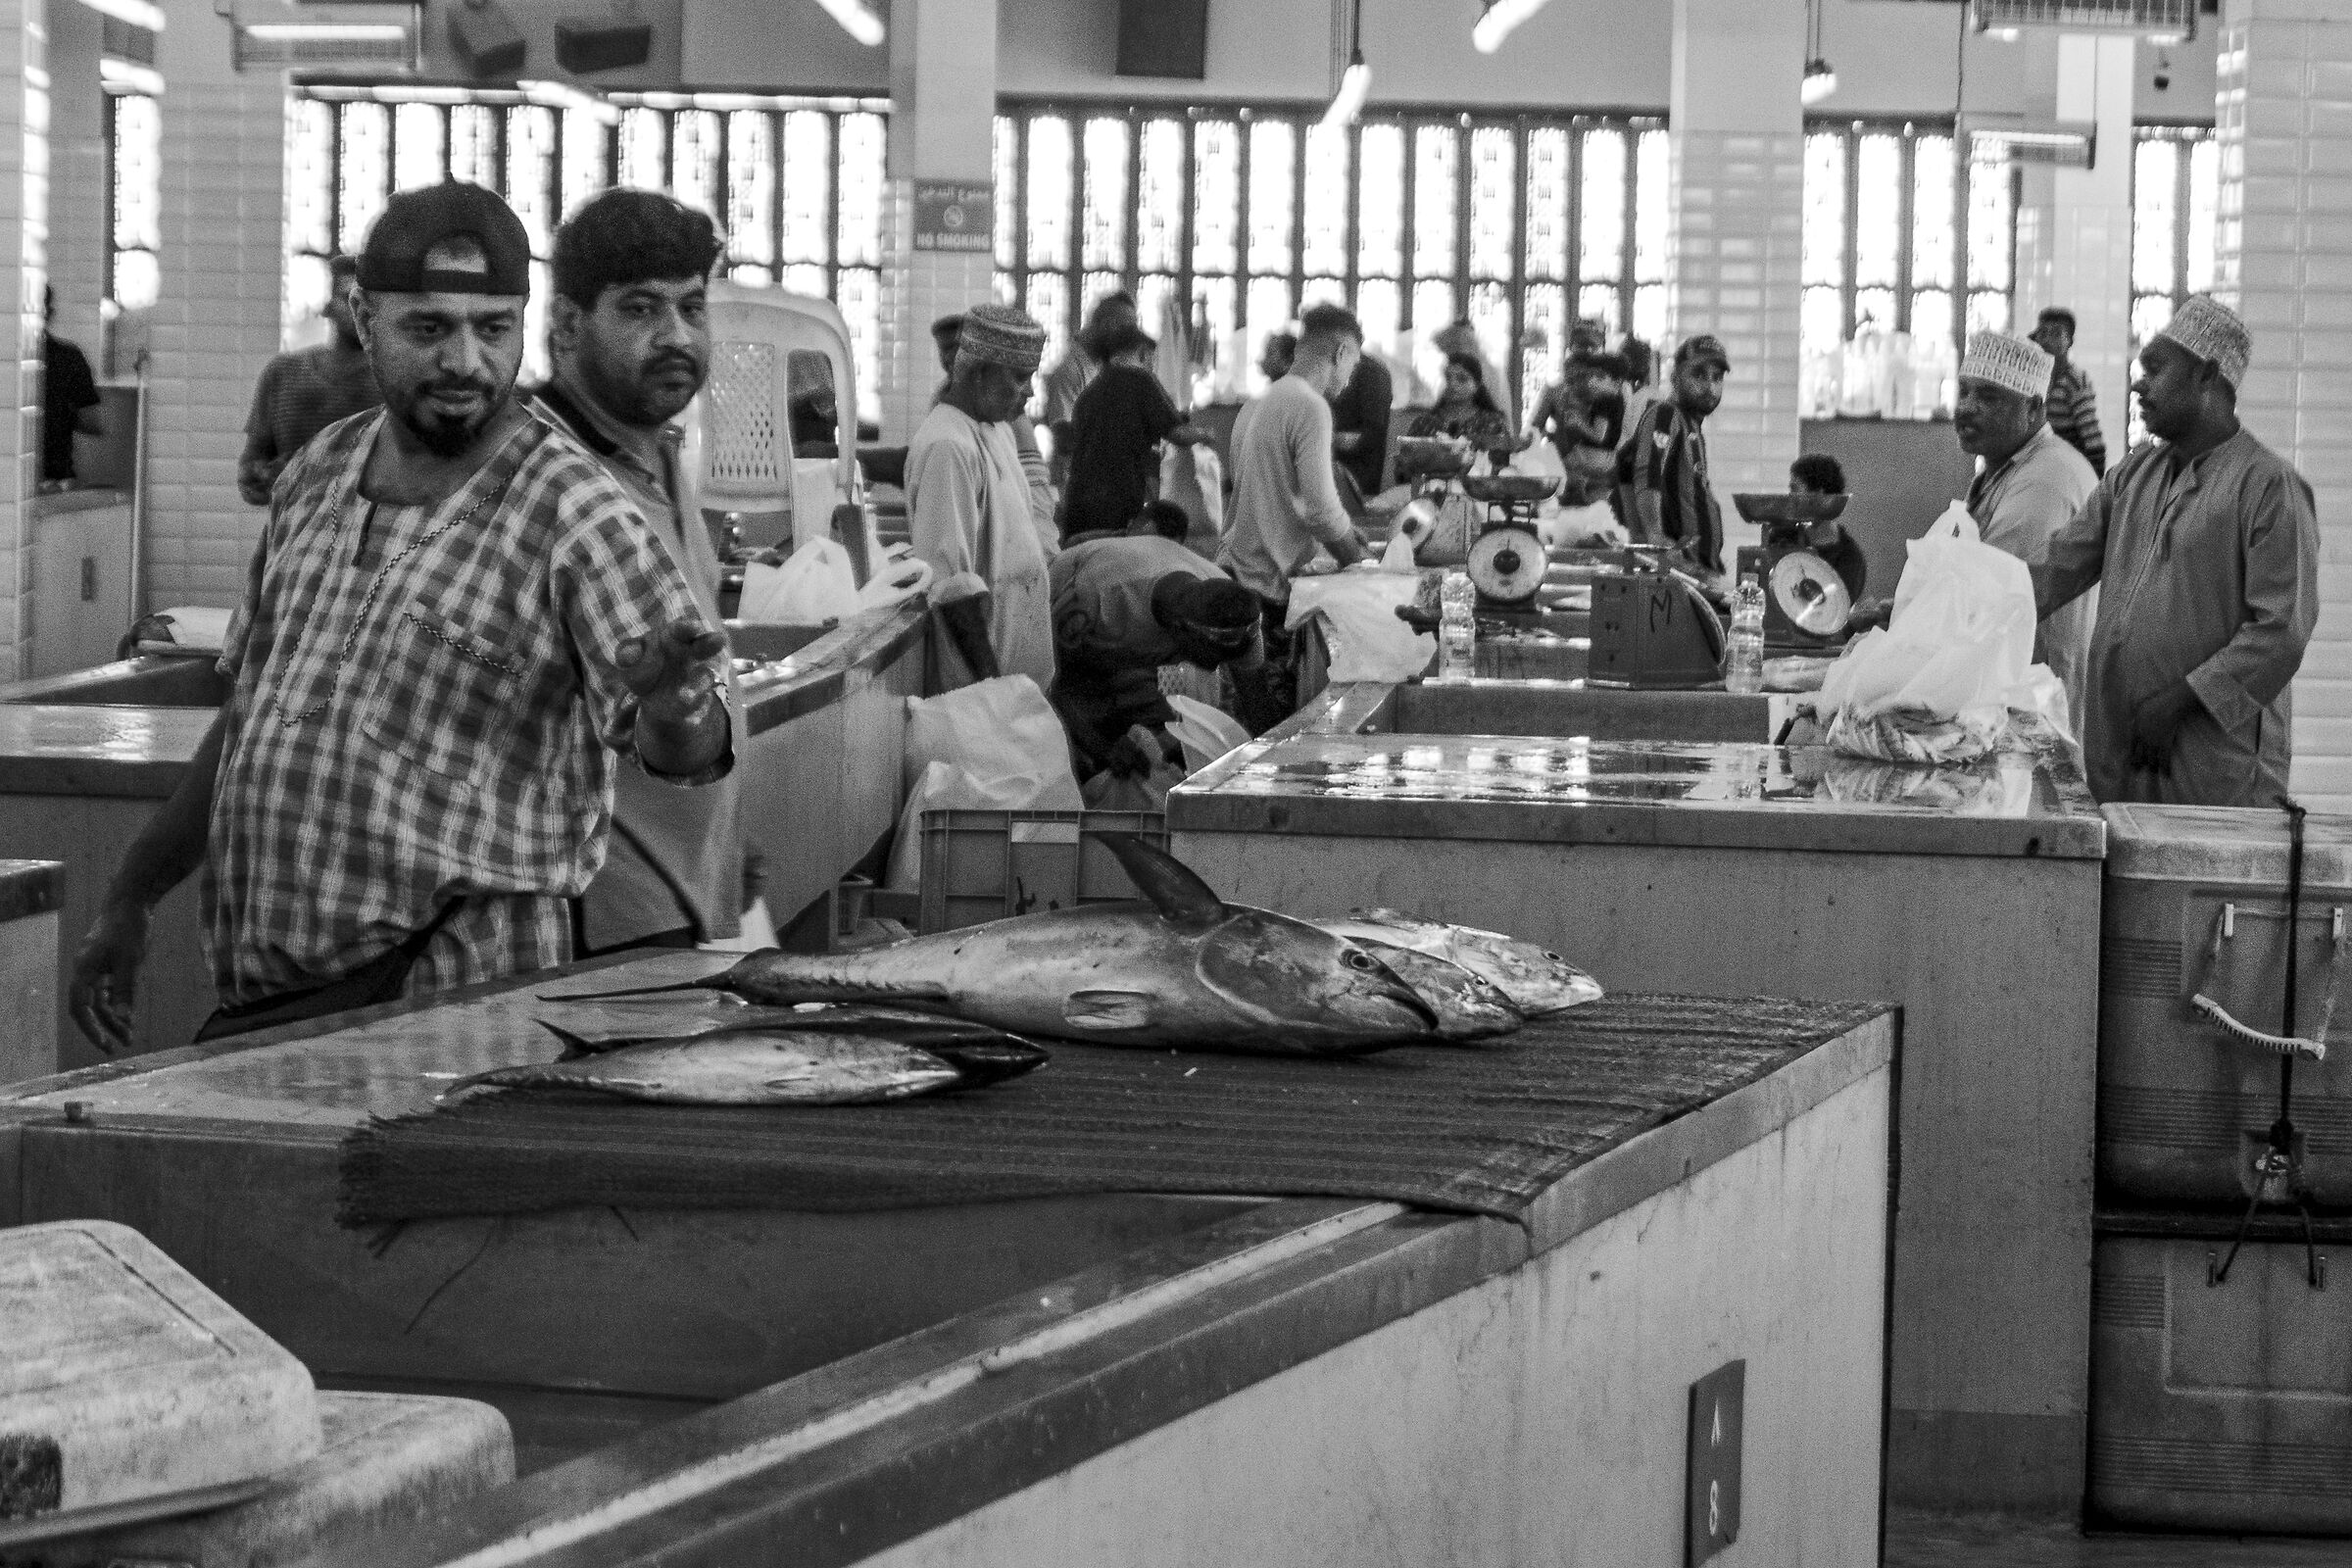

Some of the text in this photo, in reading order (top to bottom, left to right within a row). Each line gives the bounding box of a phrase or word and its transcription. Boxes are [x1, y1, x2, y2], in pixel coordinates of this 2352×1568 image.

[916, 232, 991, 250] NO SMOKING
[1649, 590, 1673, 633] M
[1708, 1479, 1719, 1537] 8
